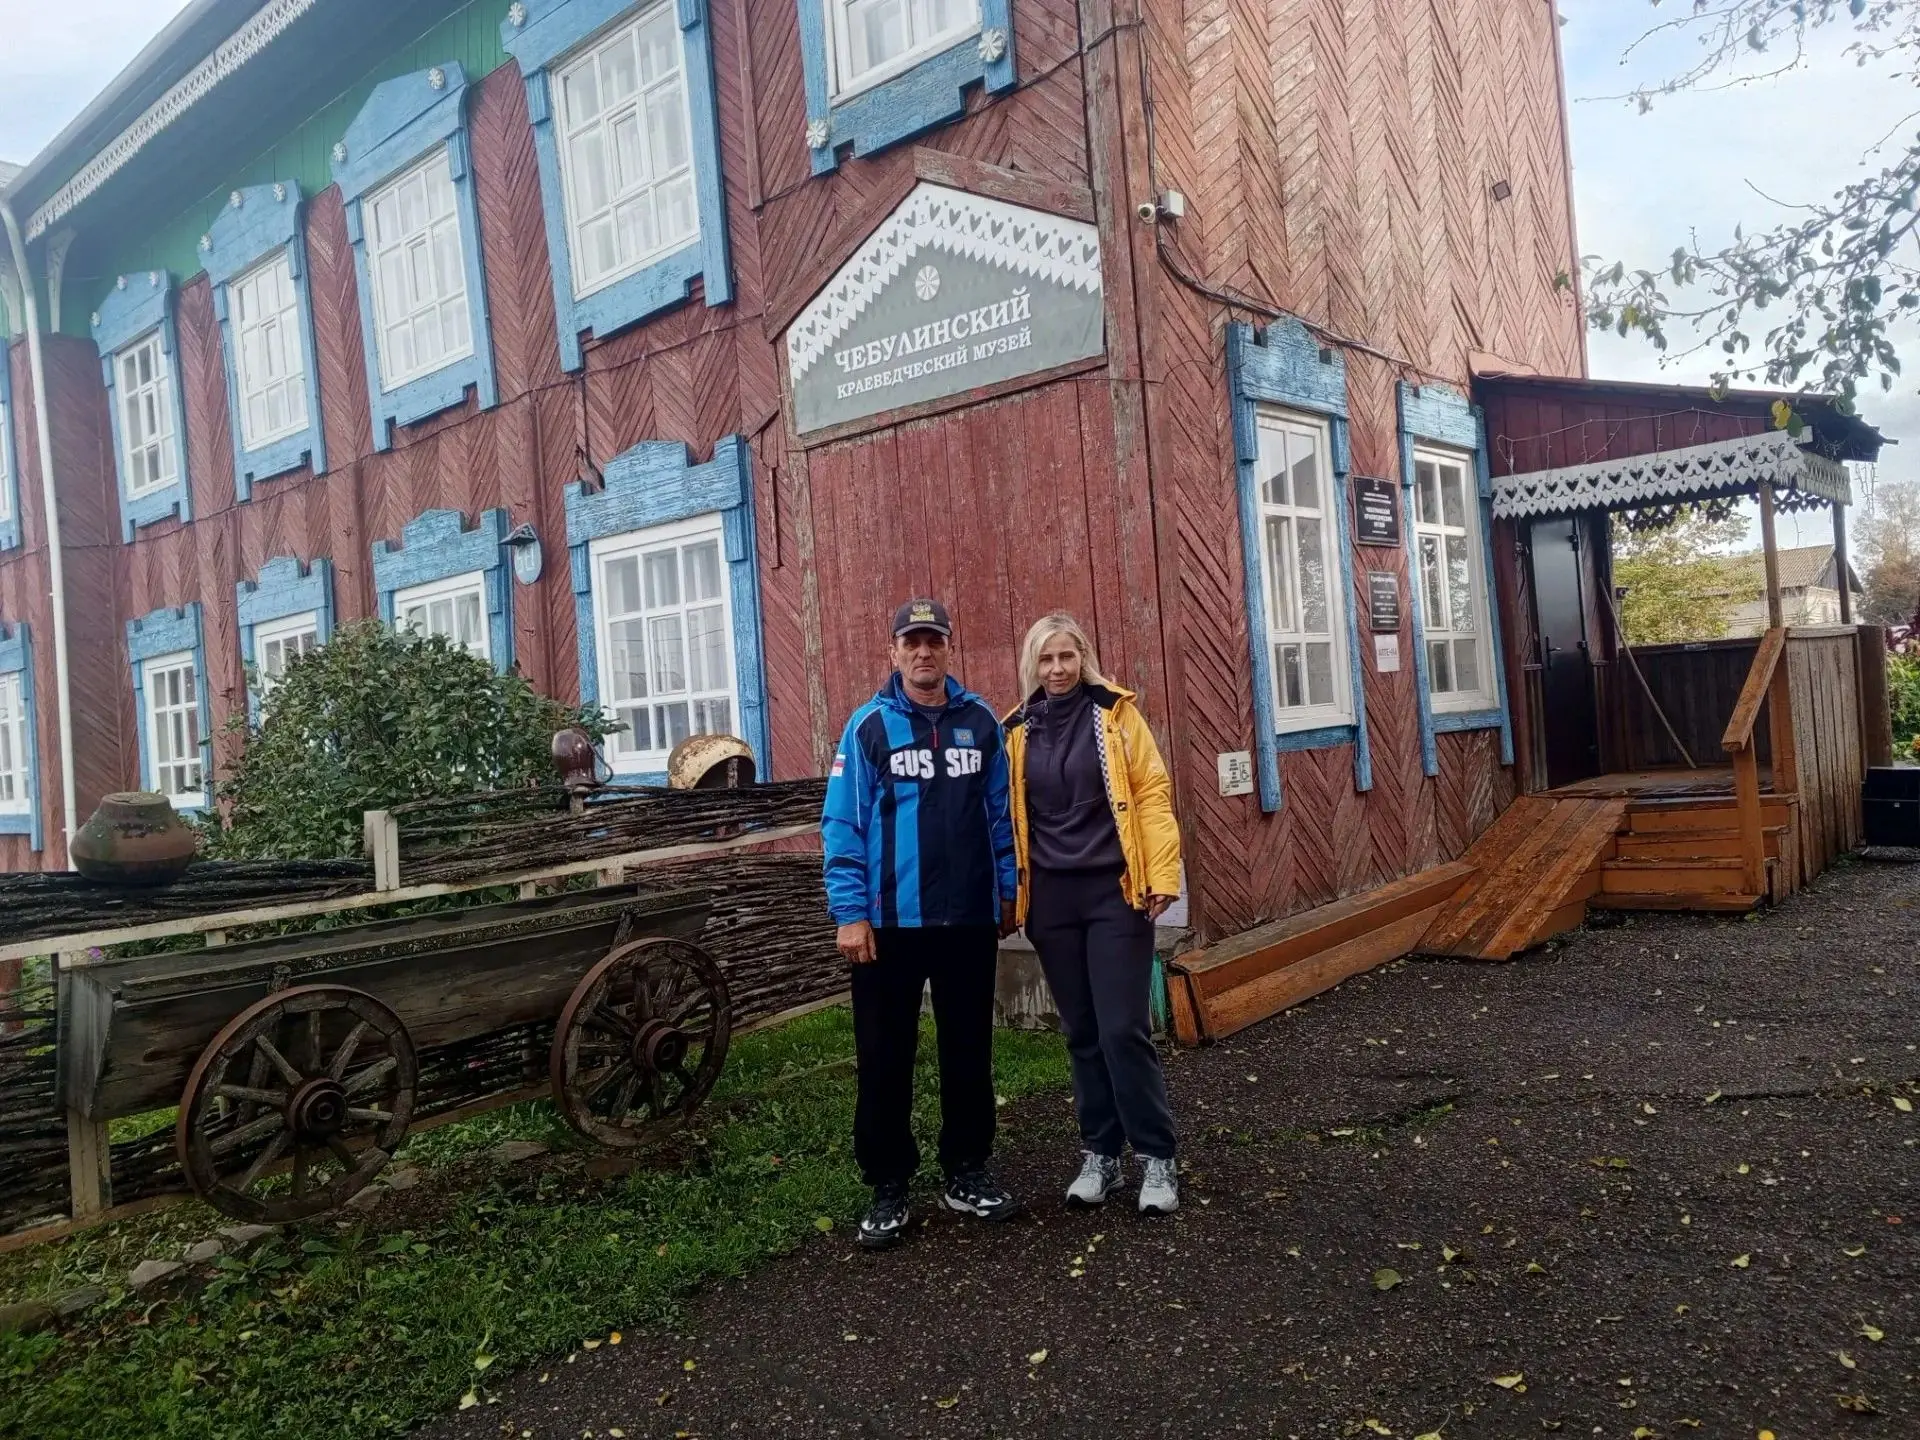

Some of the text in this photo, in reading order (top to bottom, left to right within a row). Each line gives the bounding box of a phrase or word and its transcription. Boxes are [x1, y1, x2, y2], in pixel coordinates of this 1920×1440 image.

[834, 286, 1032, 373] ЧЕБУЛИНСКИЙ
[836, 325, 1033, 400] КРАЕВЕДЧЕСКИЙ МУЗЕЙ
